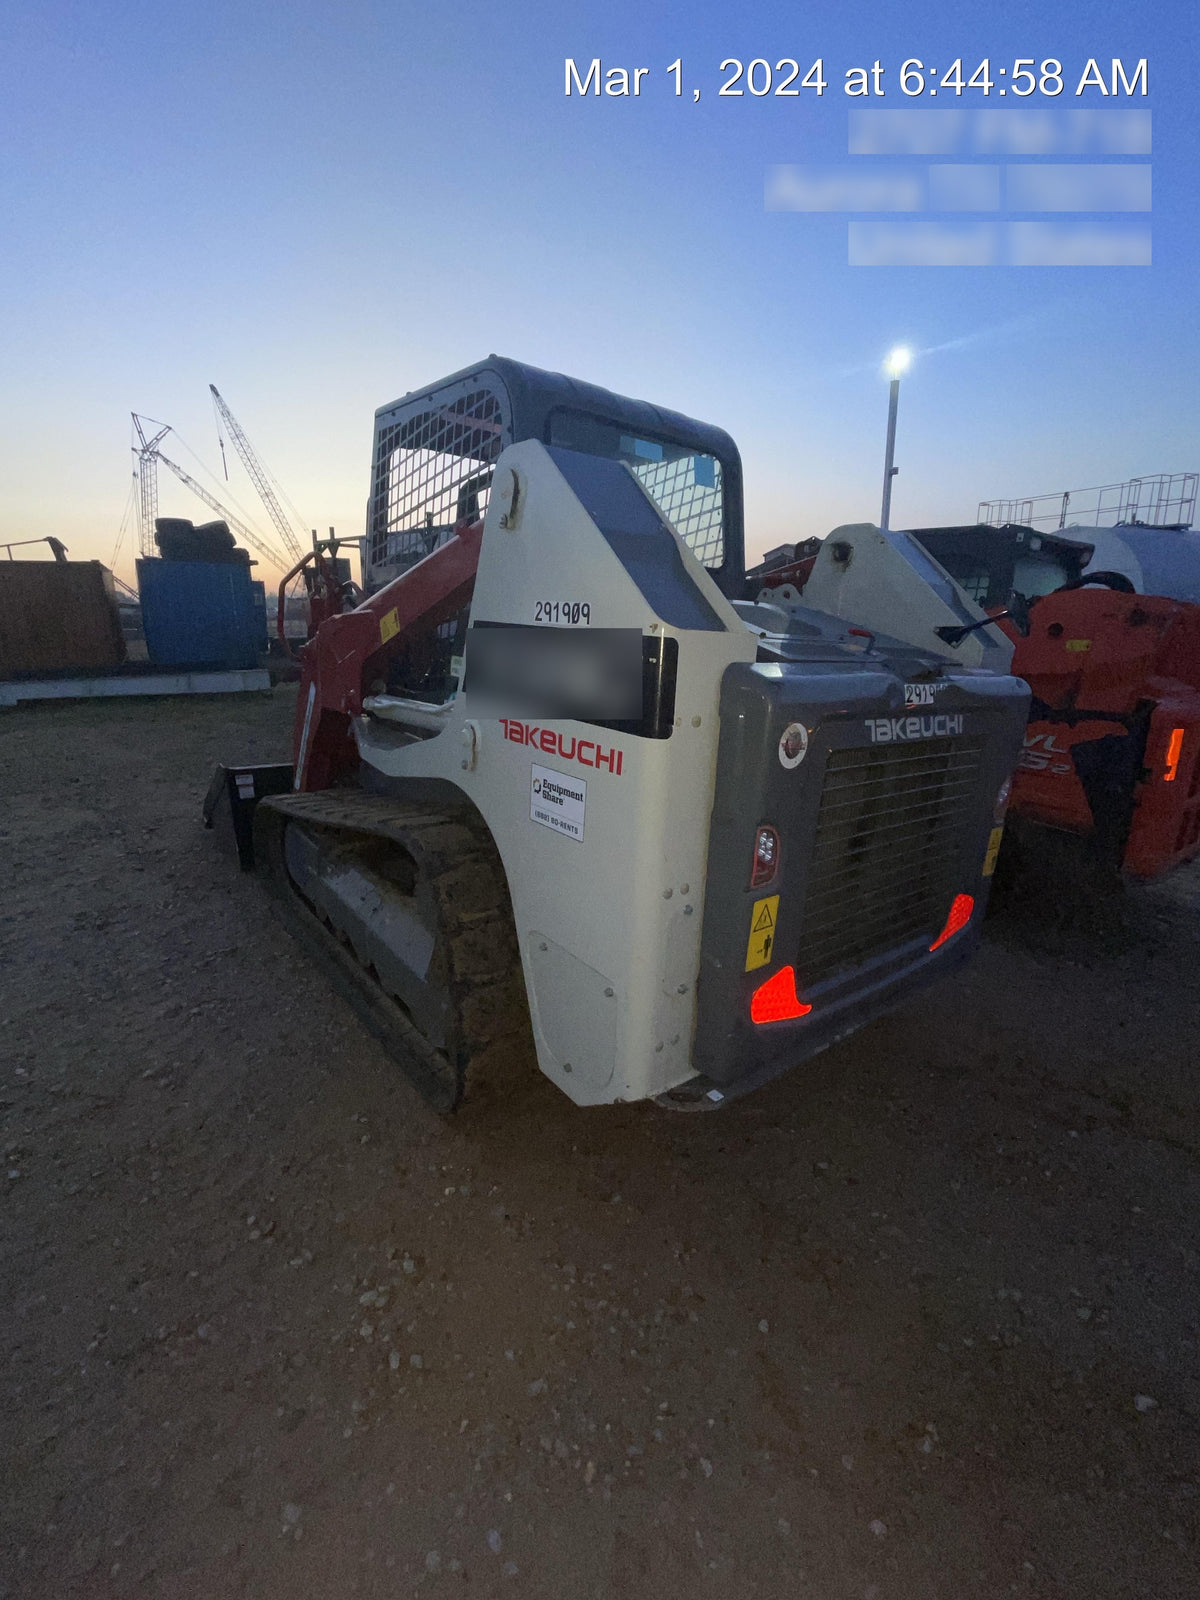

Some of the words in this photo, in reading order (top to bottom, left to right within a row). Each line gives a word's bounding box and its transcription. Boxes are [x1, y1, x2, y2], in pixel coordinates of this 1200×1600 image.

[534, 601, 591, 625] 291909
[906, 684, 946, 704] 2919
[542, 778, 584, 803] Equipment
[542, 789, 564, 806] Share
